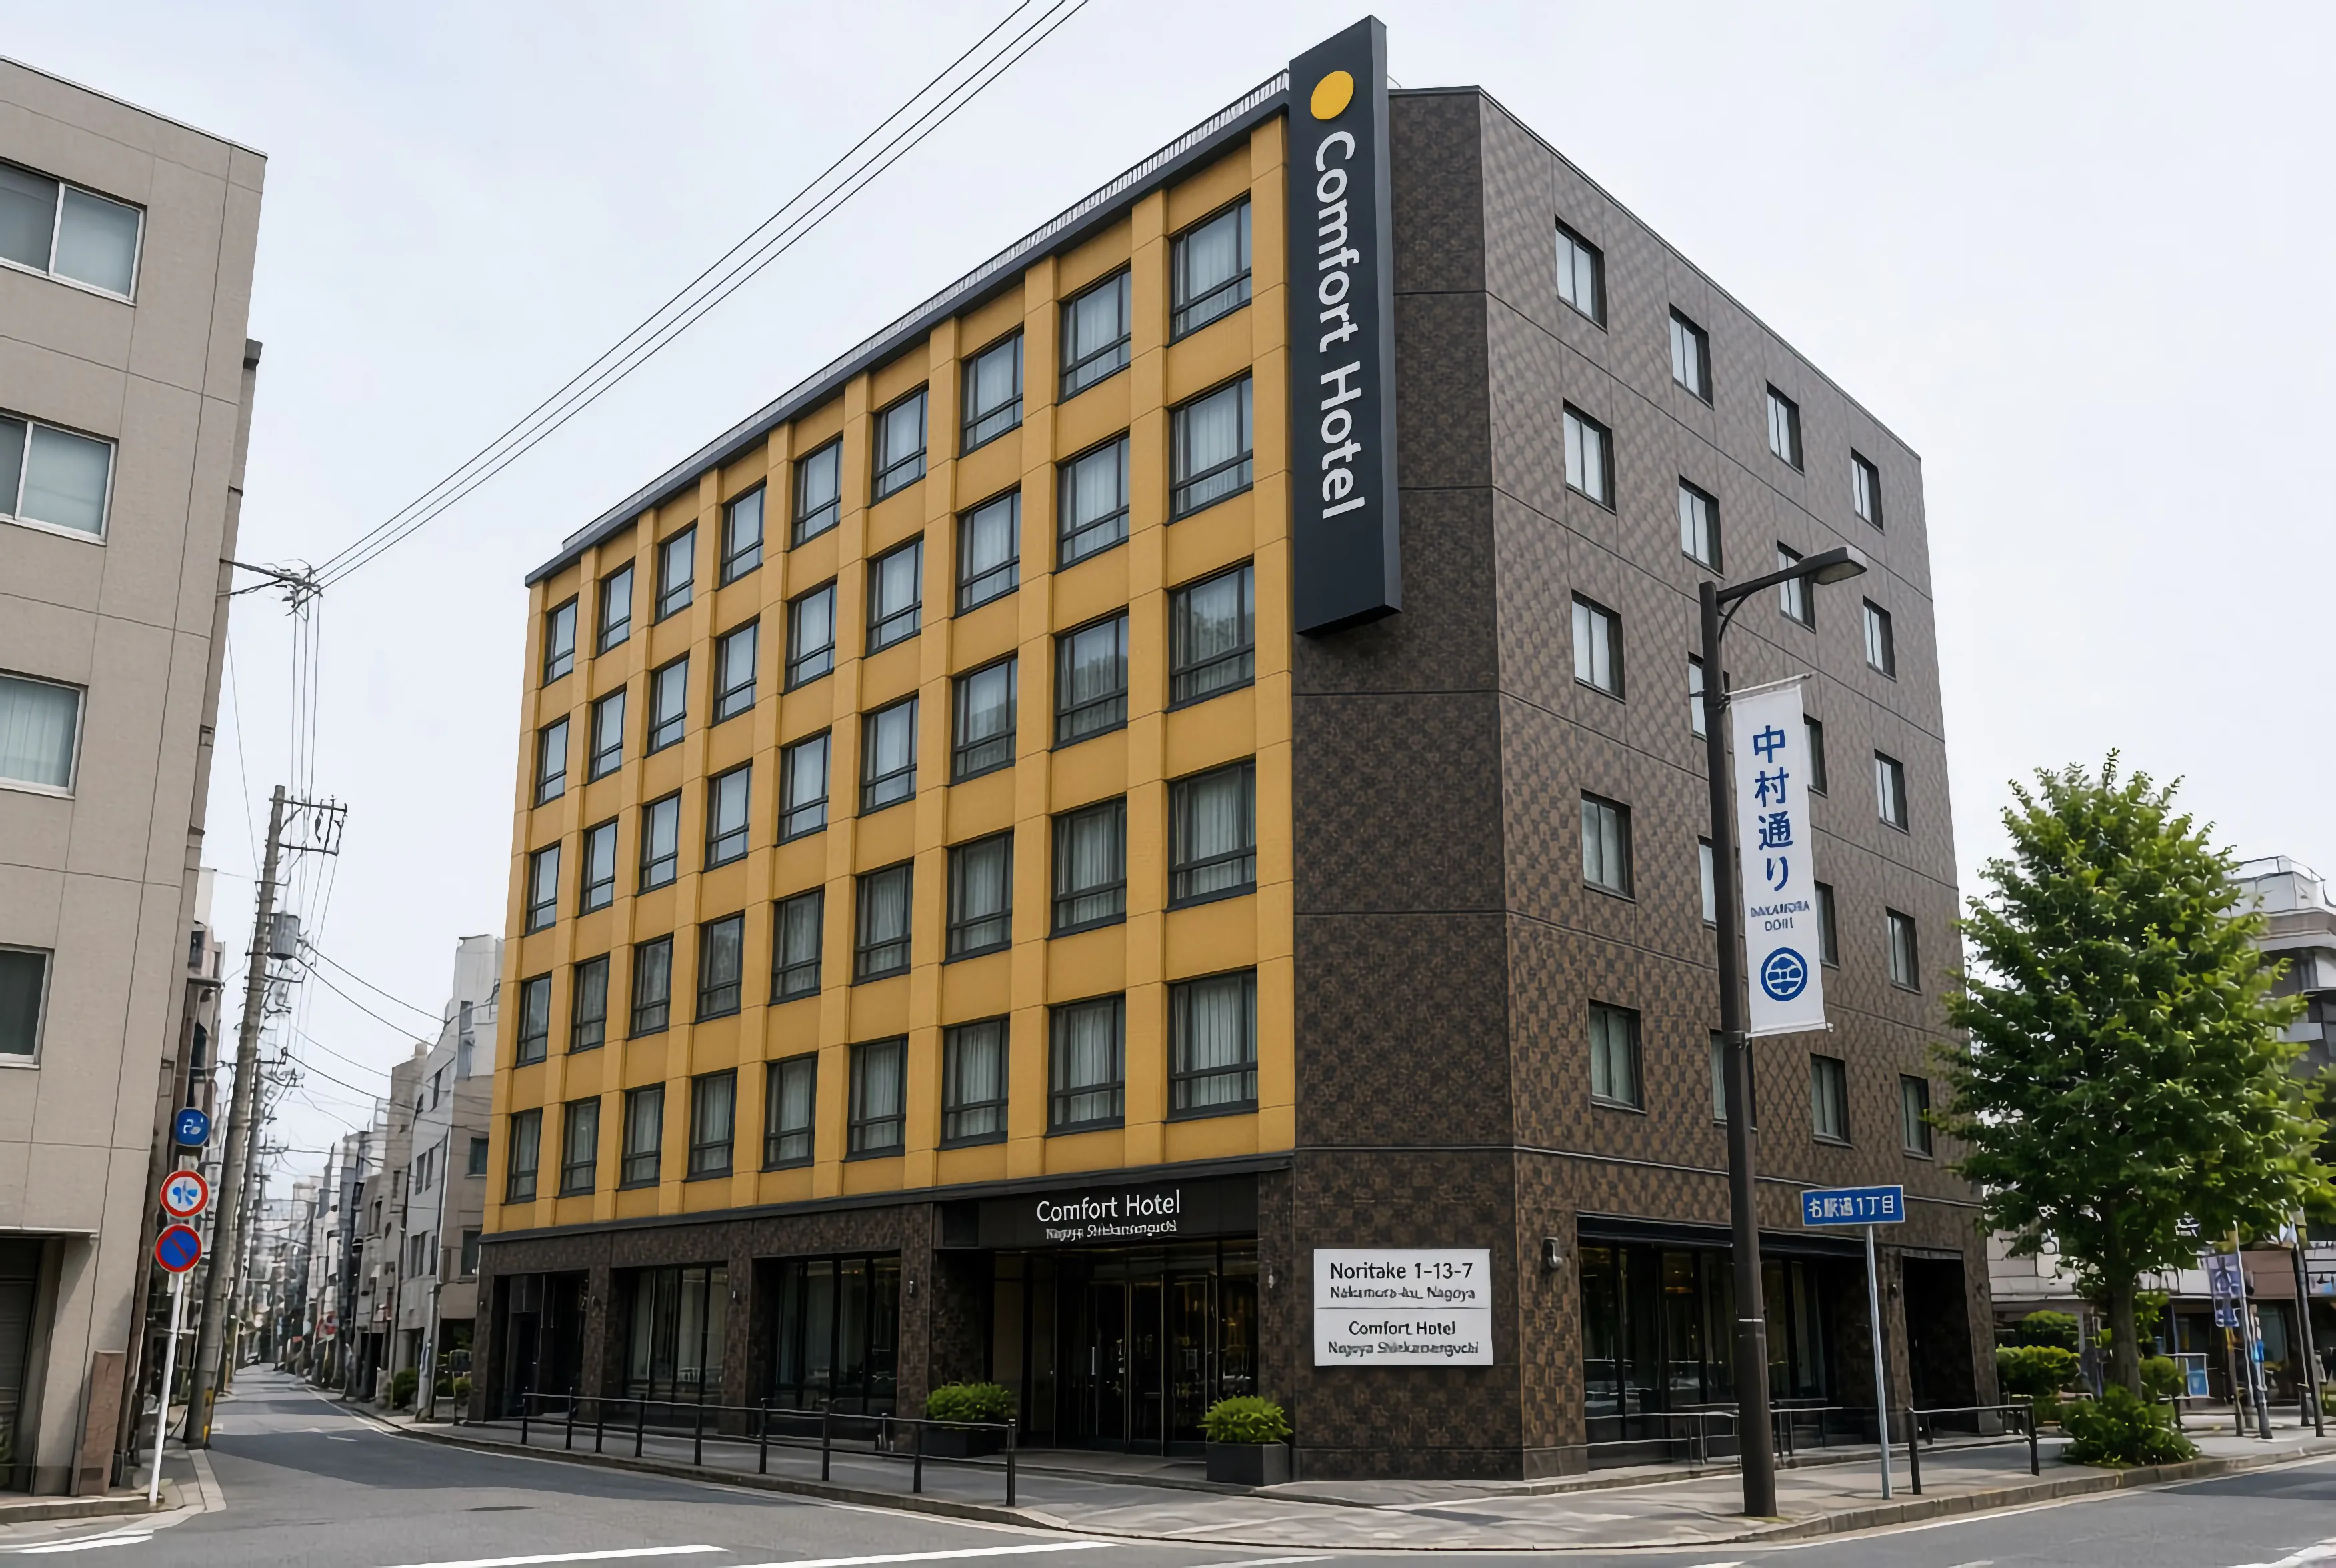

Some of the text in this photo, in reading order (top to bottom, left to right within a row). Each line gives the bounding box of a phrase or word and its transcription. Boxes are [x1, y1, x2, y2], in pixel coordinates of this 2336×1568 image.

[1315, 131, 1365, 519] Comfort Hotel
[1753, 725, 1793, 892] 中村通り
[1037, 1189, 1181, 1222] Comfort Hotel
[1331, 1261, 1473, 1279] Noritake 1-13-7
[1349, 1321, 1455, 1335] Comfort Hotel
